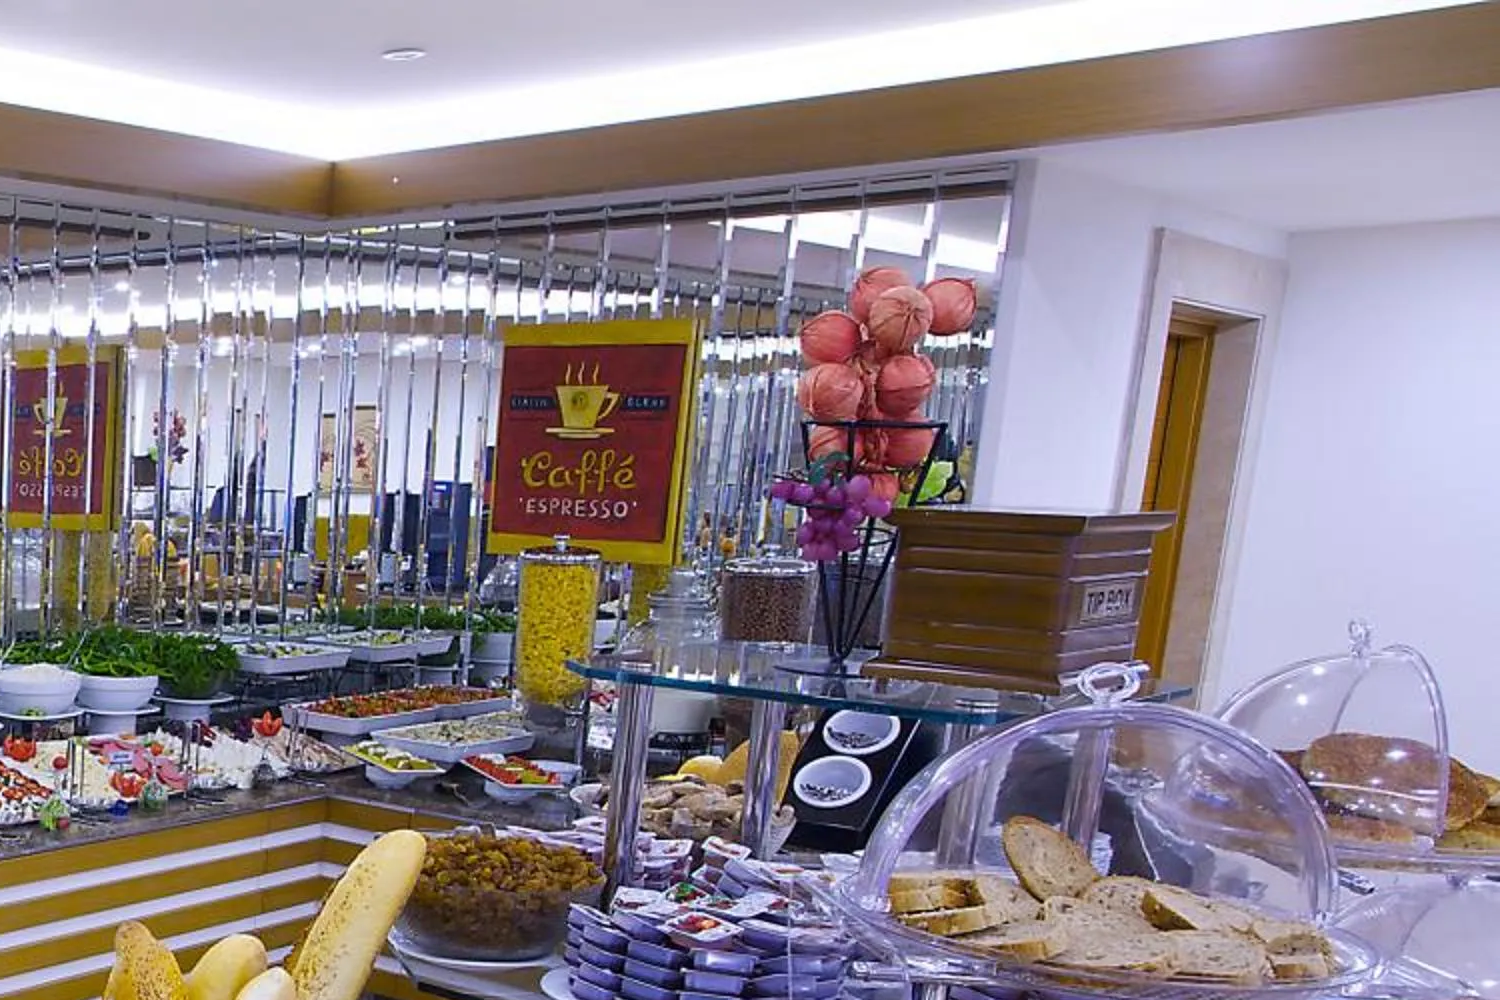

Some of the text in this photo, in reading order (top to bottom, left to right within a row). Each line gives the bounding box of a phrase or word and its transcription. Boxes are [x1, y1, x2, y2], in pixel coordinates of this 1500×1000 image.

[520, 449, 637, 495] Caffé
[1087, 588, 1133, 614] TIP BOX
